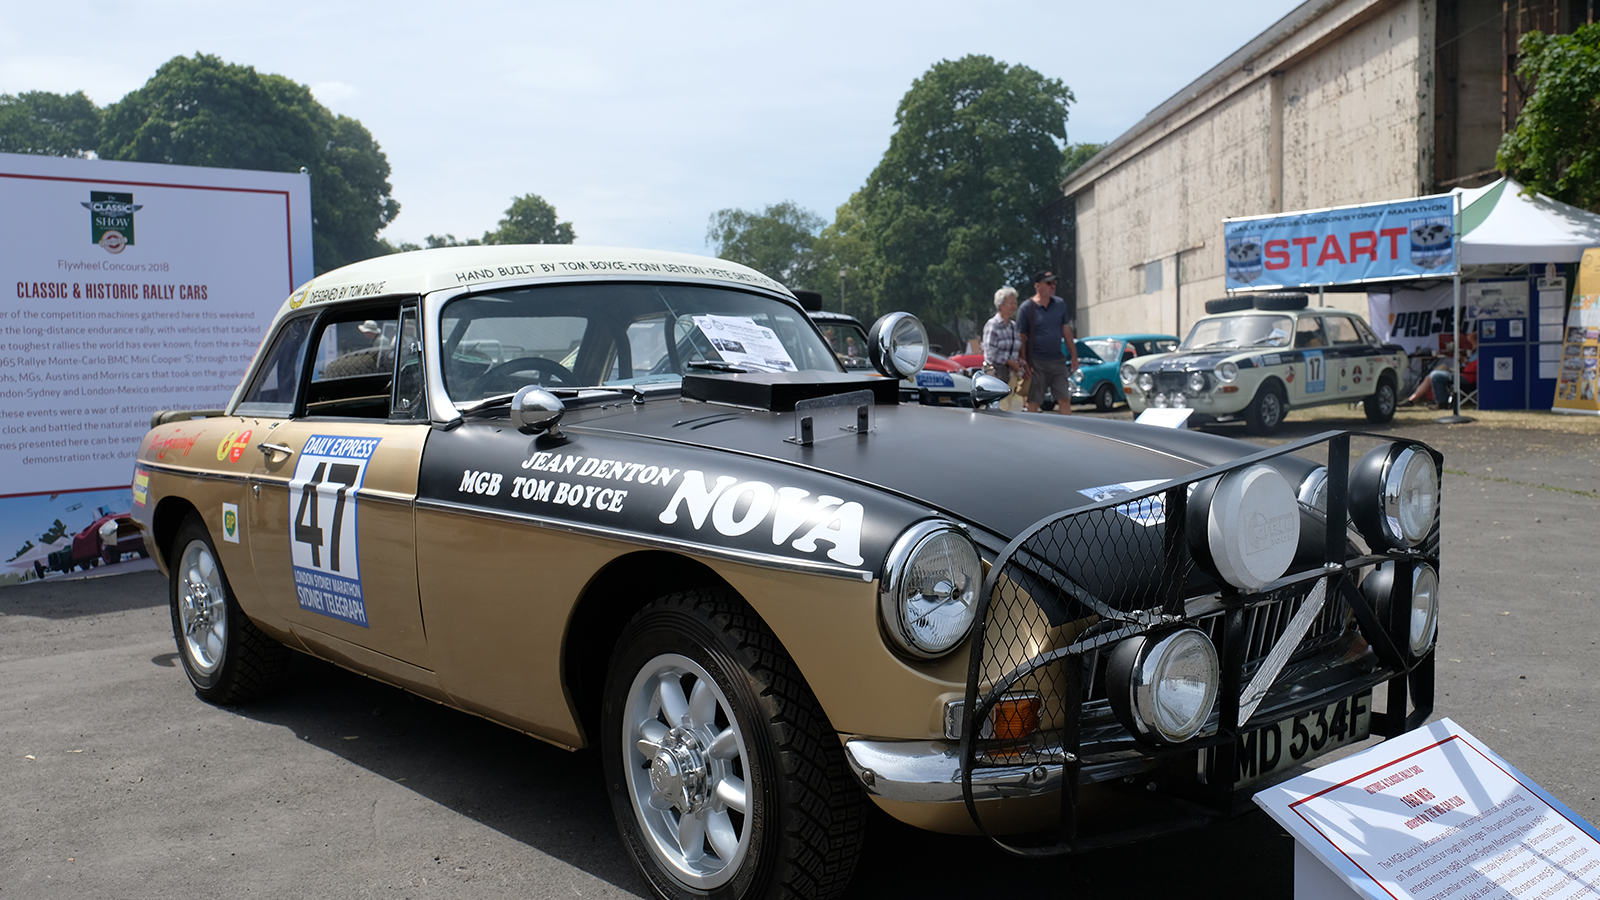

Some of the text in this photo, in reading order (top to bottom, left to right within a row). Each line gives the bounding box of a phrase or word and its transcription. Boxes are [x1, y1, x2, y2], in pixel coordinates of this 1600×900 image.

[93, 203, 131, 213] CLASSIC
[96, 217, 129, 227] SHOW
[1231, 225, 1256, 233] DAILY
[1258, 221, 1299, 230] EXPRESS
[1388, 204, 1447, 216] MARATHON
[1264, 227, 1408, 270] START
[58, 260, 168, 271] Flywheel Concours 2018
[455, 266, 494, 282] HAND
[498, 265, 535, 276] BUILT
[540, 263, 556, 272] BY
[559, 261, 589, 270] TOM
[663, 263, 705, 275] DENTON
[709, 268, 733, 280] PETE
[17, 282, 207, 300] CLASSIC & HISTORIC RALLY CARS
[309, 288, 338, 304] DESIGNED
[338, 287, 348, 299] BY
[349, 285, 364, 297] TOM
[362, 281, 386, 295] BOYCE
[11, 309, 20, 318] of
[23, 310, 38, 319] the
[41, 310, 96, 320] competition
[98, 310, 139, 318] machines
[141, 310, 179, 320] gathered
[5, 325, 20, 334] the
[23, 325, 85, 337] long-distance
[88, 325, 133, 334] endurance
[135, 326, 154, 335] rally,
[8, 341, 50, 352] toughest
[52, 341, 80, 349] rallies
[83, 341, 96, 349] the
[17, 357, 46, 367] Rallye
[48, 355, 105, 365] Monte-Carlo
[108, 355, 128, 364] BMC
[151, 355, 181, 364] Cooper
[196, 354, 227, 364] through
[1310, 358, 1320, 380] 17
[19, 372, 42, 382] MGs,
[45, 372, 79, 380] Austins
[82, 371, 98, 380] and
[100, 371, 129, 379] Morris
[63, 387, 79, 395] and
[81, 386, 148, 395] London-Mexico
[0, 410, 24, 418] hese
[27, 409, 57, 417] events
[110, 405, 118, 413] of
[121, 405, 157, 414] attrition
[2, 424, 26, 434] clock
[29, 424, 46, 432] and
[48, 422, 81, 432] battled
[84, 422, 98, 430] the
[101, 420, 131, 428] natural
[19, 438, 66, 451] presented
[68, 438, 88, 446] here
[303, 437, 377, 458] DAILY EXPRESS
[23, 453, 90, 464] demonstration
[93, 451, 114, 459] track
[522, 451, 680, 487] JEAN DENTON
[458, 470, 628, 513] MGB TOM BOYCE
[226, 514, 236, 530] BP
[295, 462, 360, 572] 47
[658, 470, 864, 566] NOVA
[294, 570, 361, 598] LONDON SYDNEY MARATHON
[297, 586, 366, 622] SYDNEY TELEGRAPH
[1289, 692, 1371, 760] 534F
[1399, 787, 1435, 808] 1968 MGB
[1404, 795, 1465, 829] entered by THE MG CAR CLUB
[1387, 852, 1406, 865] MGB
